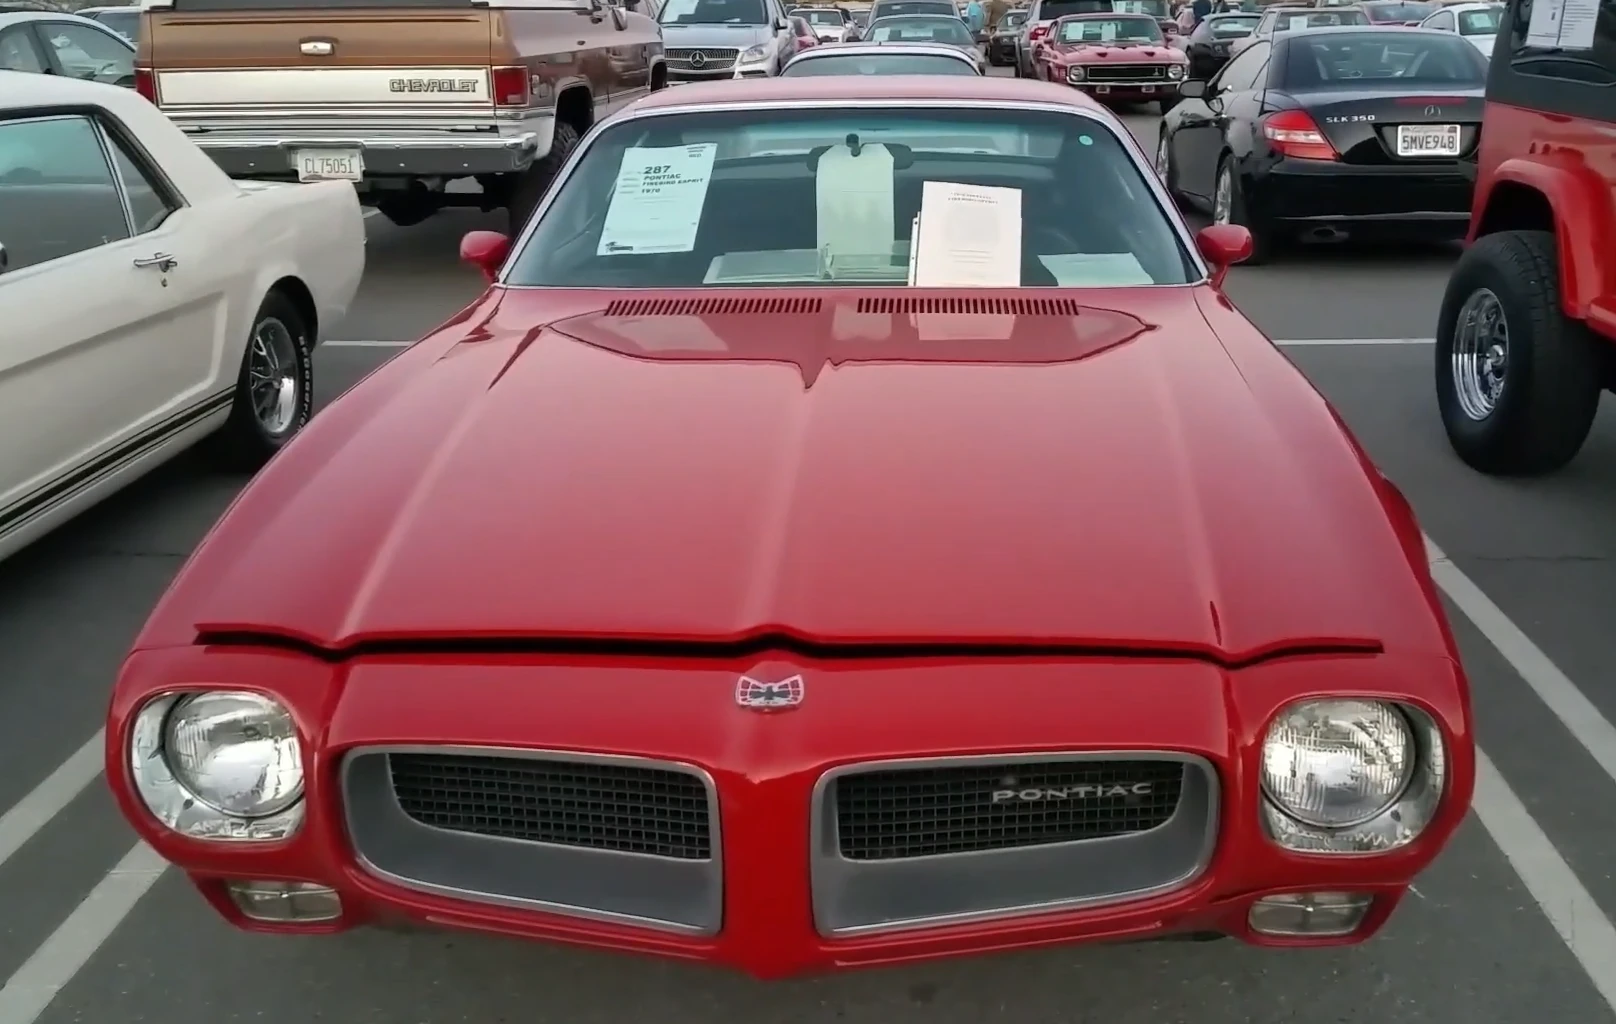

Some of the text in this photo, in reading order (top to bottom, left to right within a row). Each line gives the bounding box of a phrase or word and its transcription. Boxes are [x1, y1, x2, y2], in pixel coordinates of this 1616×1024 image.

[389, 79, 478, 92] CHEVROLET
[1351, 114, 1376, 122] 350
[1402, 135, 1455, 150] 5MVE948
[304, 157, 355, 174] CL75051
[643, 165, 671, 175] 287
[643, 173, 681, 181] PONTIAC
[992, 782, 1152, 803] PONTIAC
